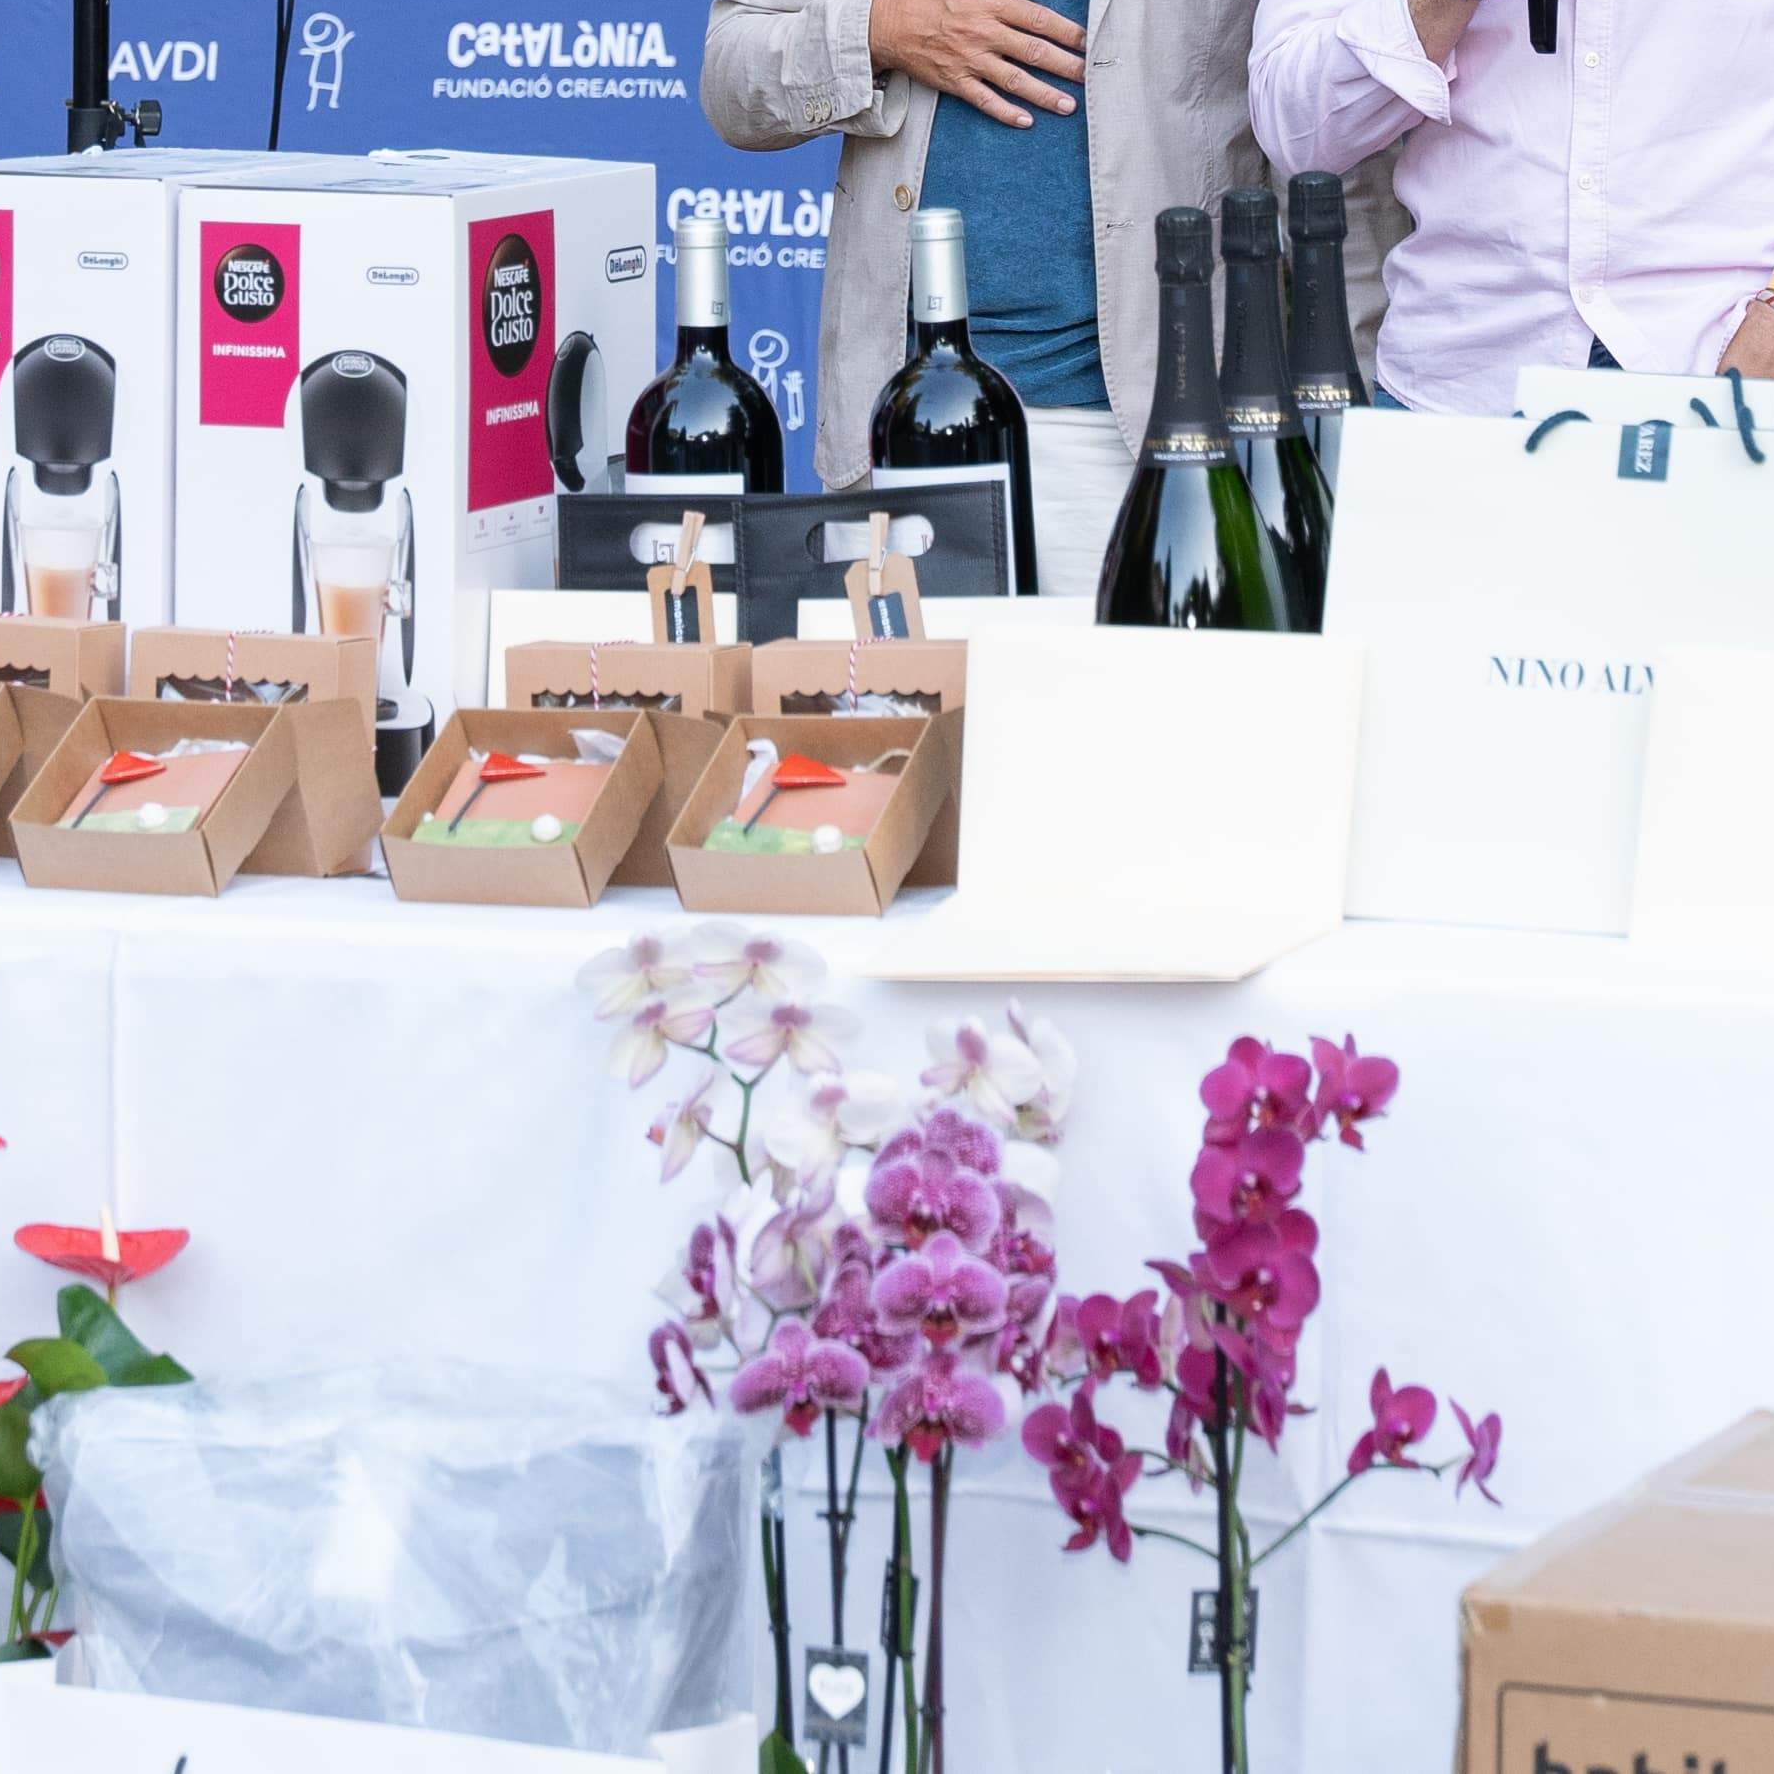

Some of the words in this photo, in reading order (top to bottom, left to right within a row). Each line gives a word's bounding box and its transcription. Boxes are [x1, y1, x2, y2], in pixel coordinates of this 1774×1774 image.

[108, 40, 219, 83] AVDI
[433, 74, 550, 101] FUNDACIÓ
[556, 76, 687, 101] CREACTIVA
[223, 272, 274, 292] Dolce
[223, 288, 275, 307] Gusto
[490, 286, 533, 322] Dolce
[490, 315, 534, 348] Gusto
[212, 343, 287, 359] INFINISSIMA
[486, 401, 539, 426] INFINISSIMA
[1486, 653, 1587, 694] NINO
